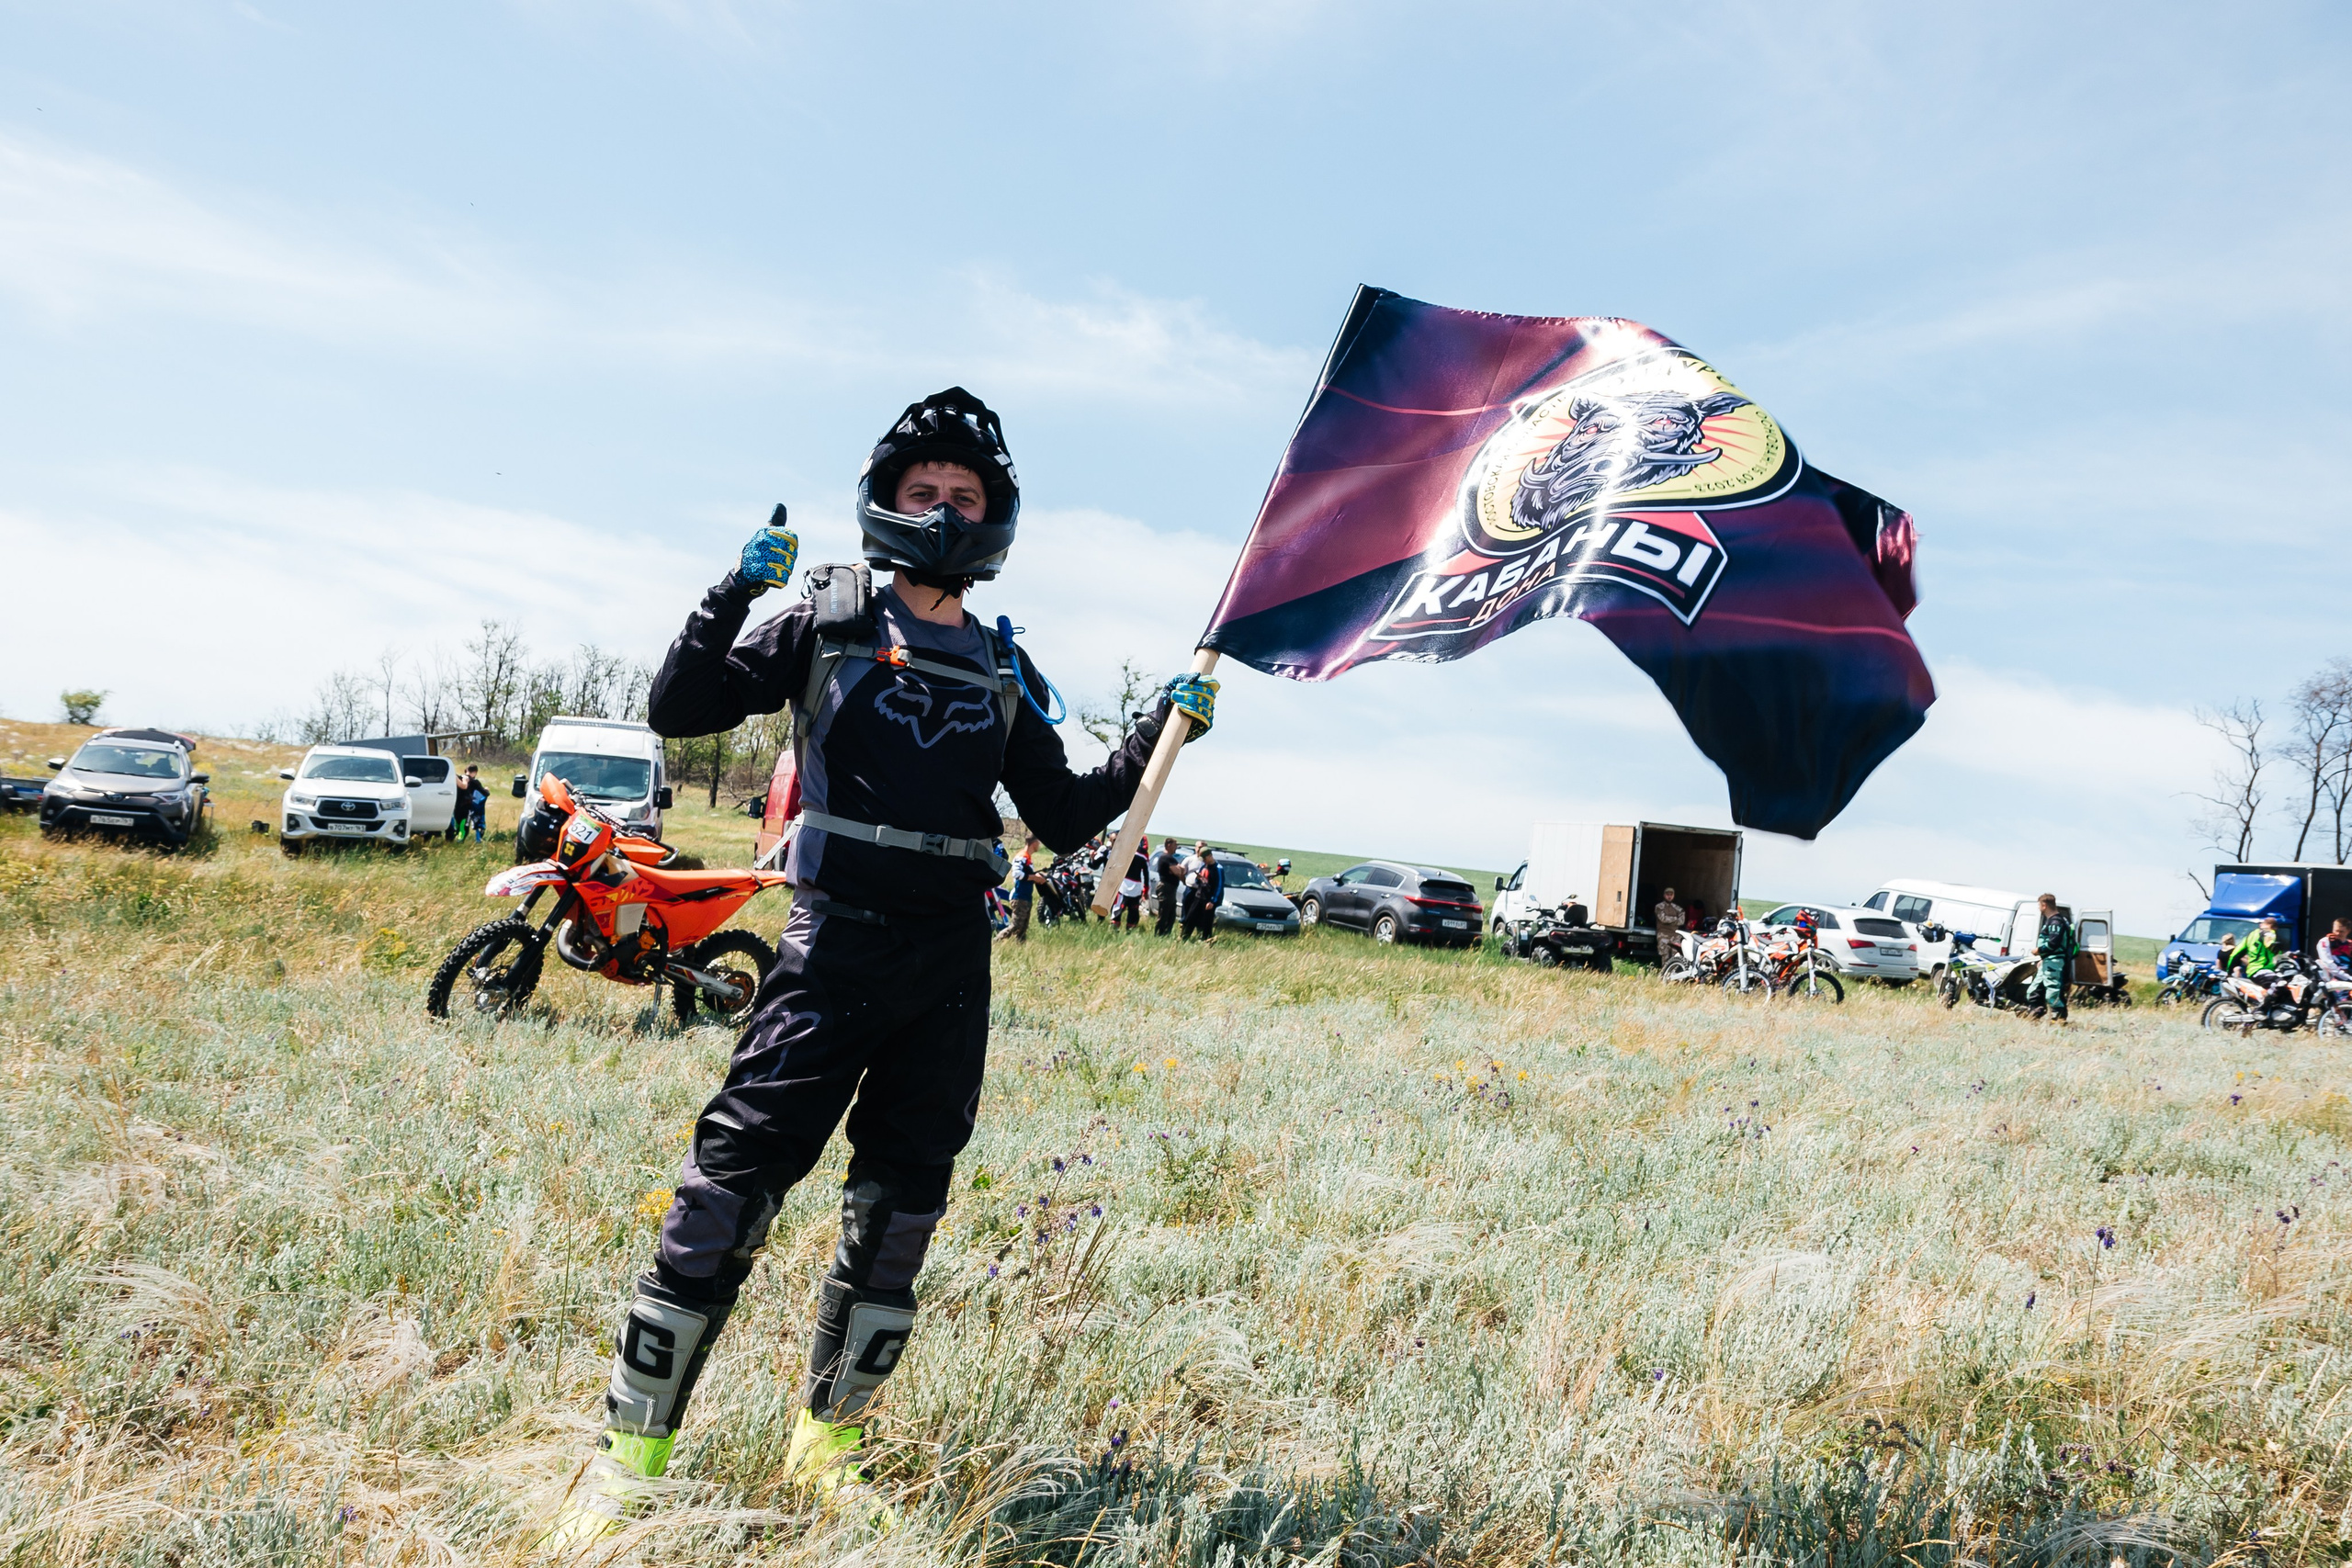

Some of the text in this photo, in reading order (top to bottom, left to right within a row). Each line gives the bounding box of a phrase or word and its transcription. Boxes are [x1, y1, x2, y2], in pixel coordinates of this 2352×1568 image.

[1399, 521, 1713, 617] КАБАНЫ
[1468, 562, 1556, 626] ДОНА
[571, 822, 593, 840] 621
[623, 1310, 675, 1380] G
[854, 1329, 910, 1375] G
